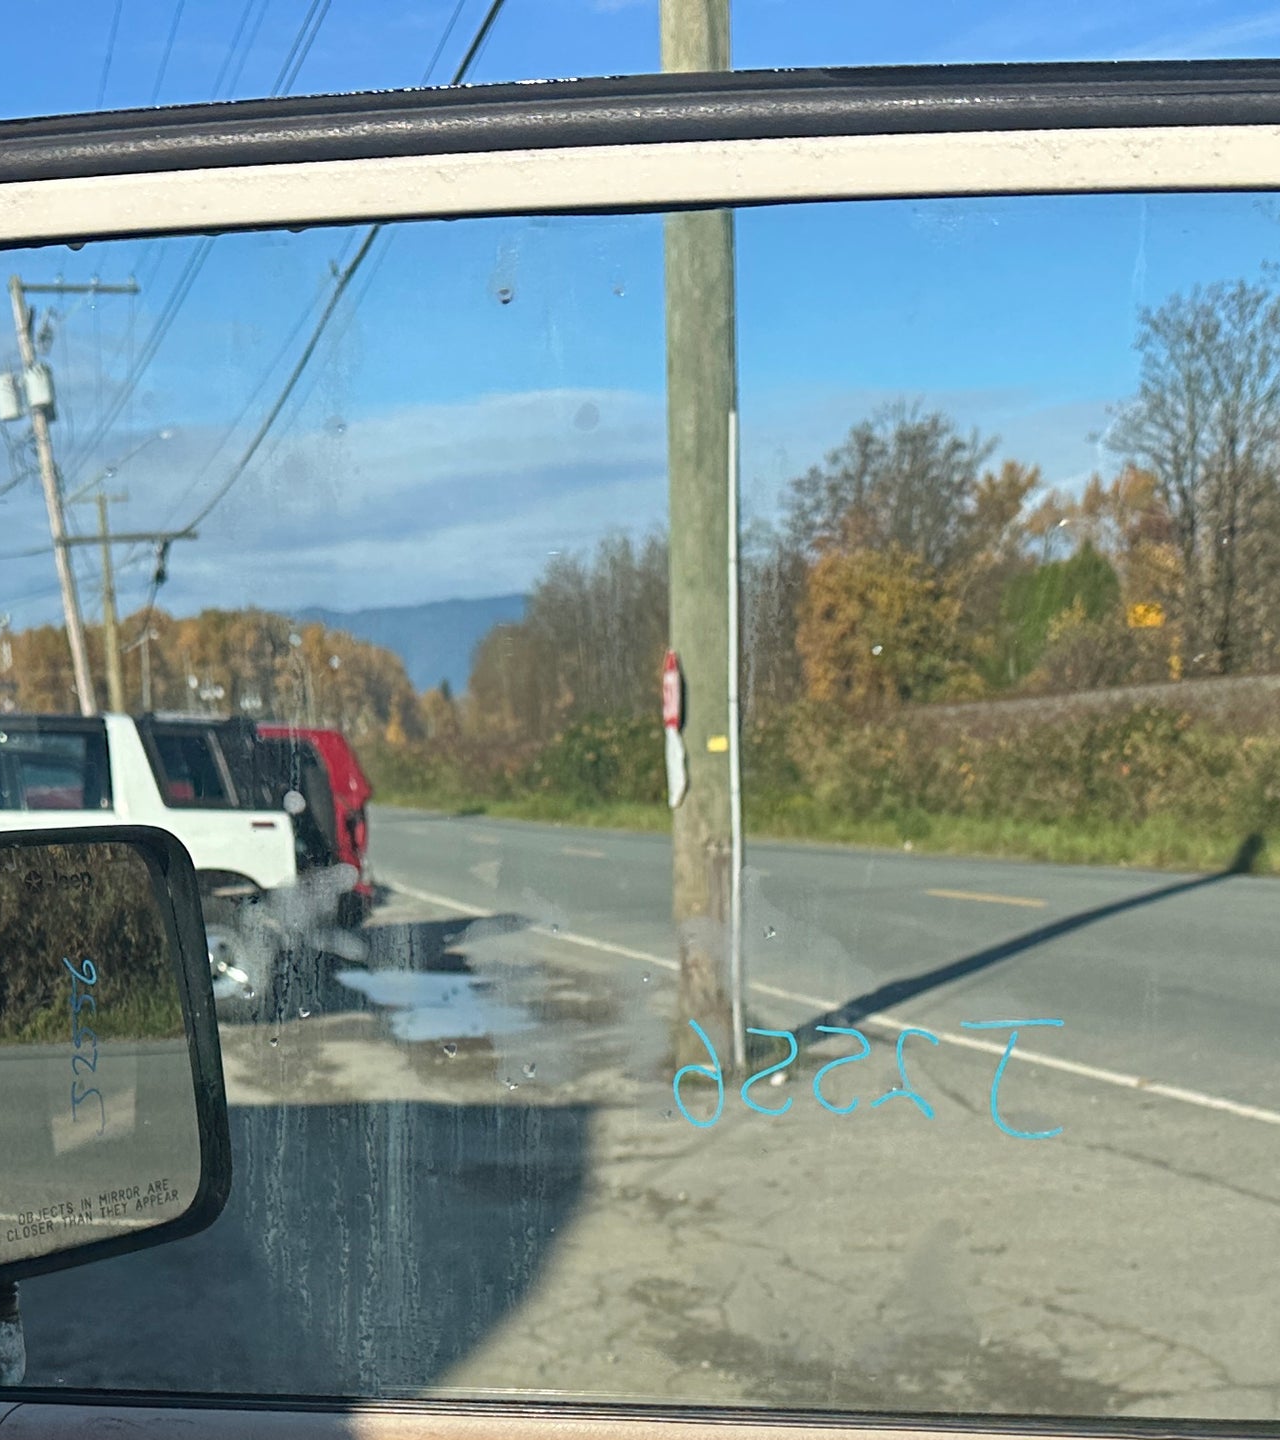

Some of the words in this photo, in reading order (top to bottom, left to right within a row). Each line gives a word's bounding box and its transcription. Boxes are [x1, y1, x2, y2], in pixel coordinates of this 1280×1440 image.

[6, 1219, 55, 1243] CLOSER
[63, 1210, 93, 1229] THAN
[100, 1202, 128, 1219] THEY
[136, 1189, 180, 1212] APPEAR
[18, 1201, 74, 1226] OBJECTS
[81, 1196, 92, 1212] IN
[98, 1185, 141, 1207] MIRROR
[147, 1178, 169, 1196] ARE
